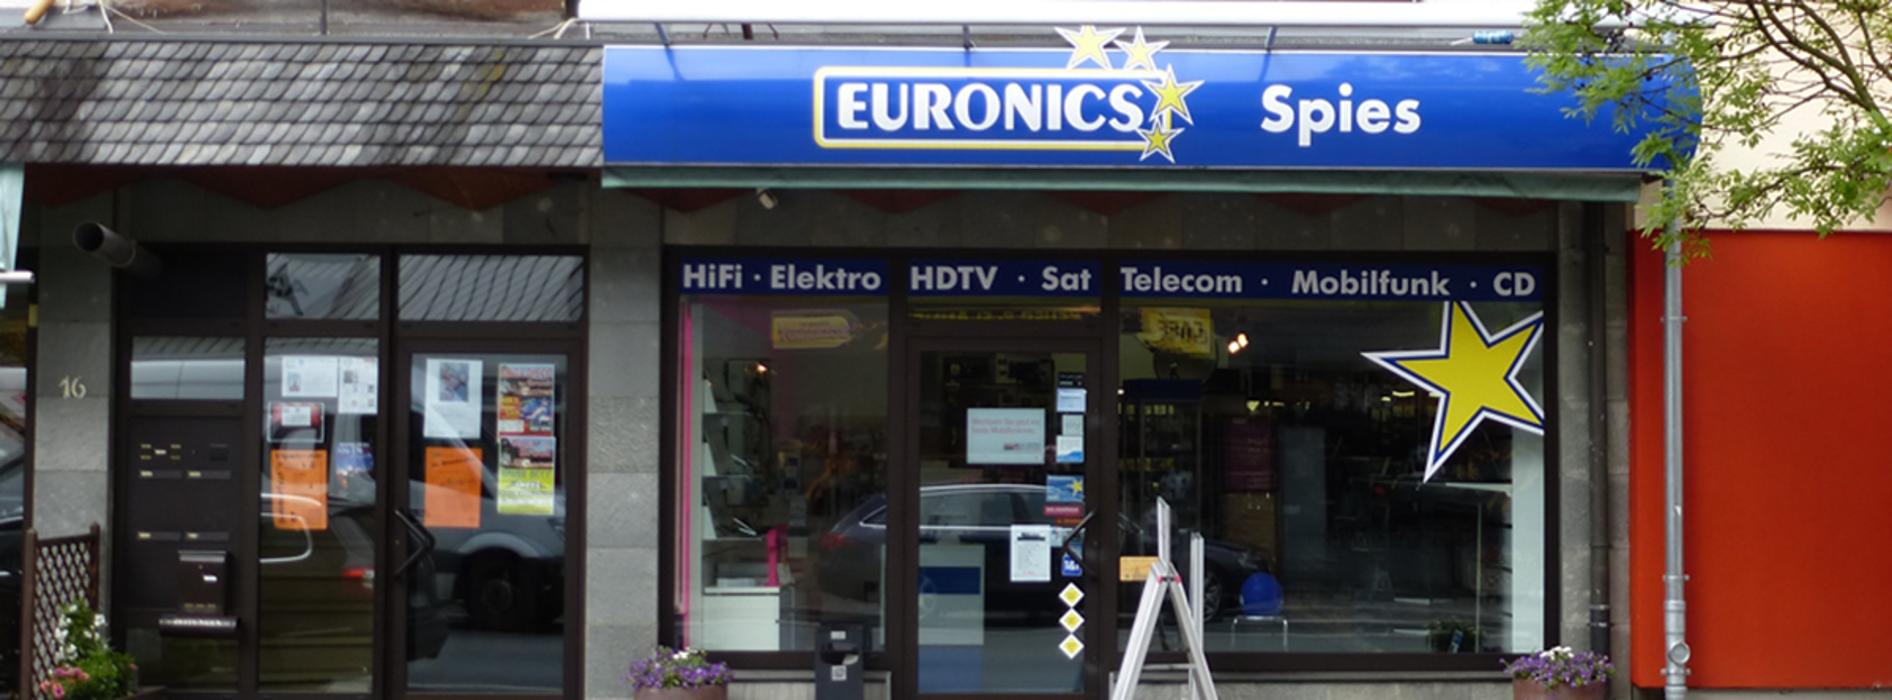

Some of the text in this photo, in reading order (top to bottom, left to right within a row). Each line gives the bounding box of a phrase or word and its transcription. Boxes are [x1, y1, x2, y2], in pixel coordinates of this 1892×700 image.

[837, 82, 1421, 147] EURONICS Spies
[683, 264, 881, 290] HiFi Elektro
[910, 266, 1092, 291] HDTV Sat
[1120, 266, 1536, 296] Telecom Mobilfunk CD
[59, 374, 87, 399] 16
